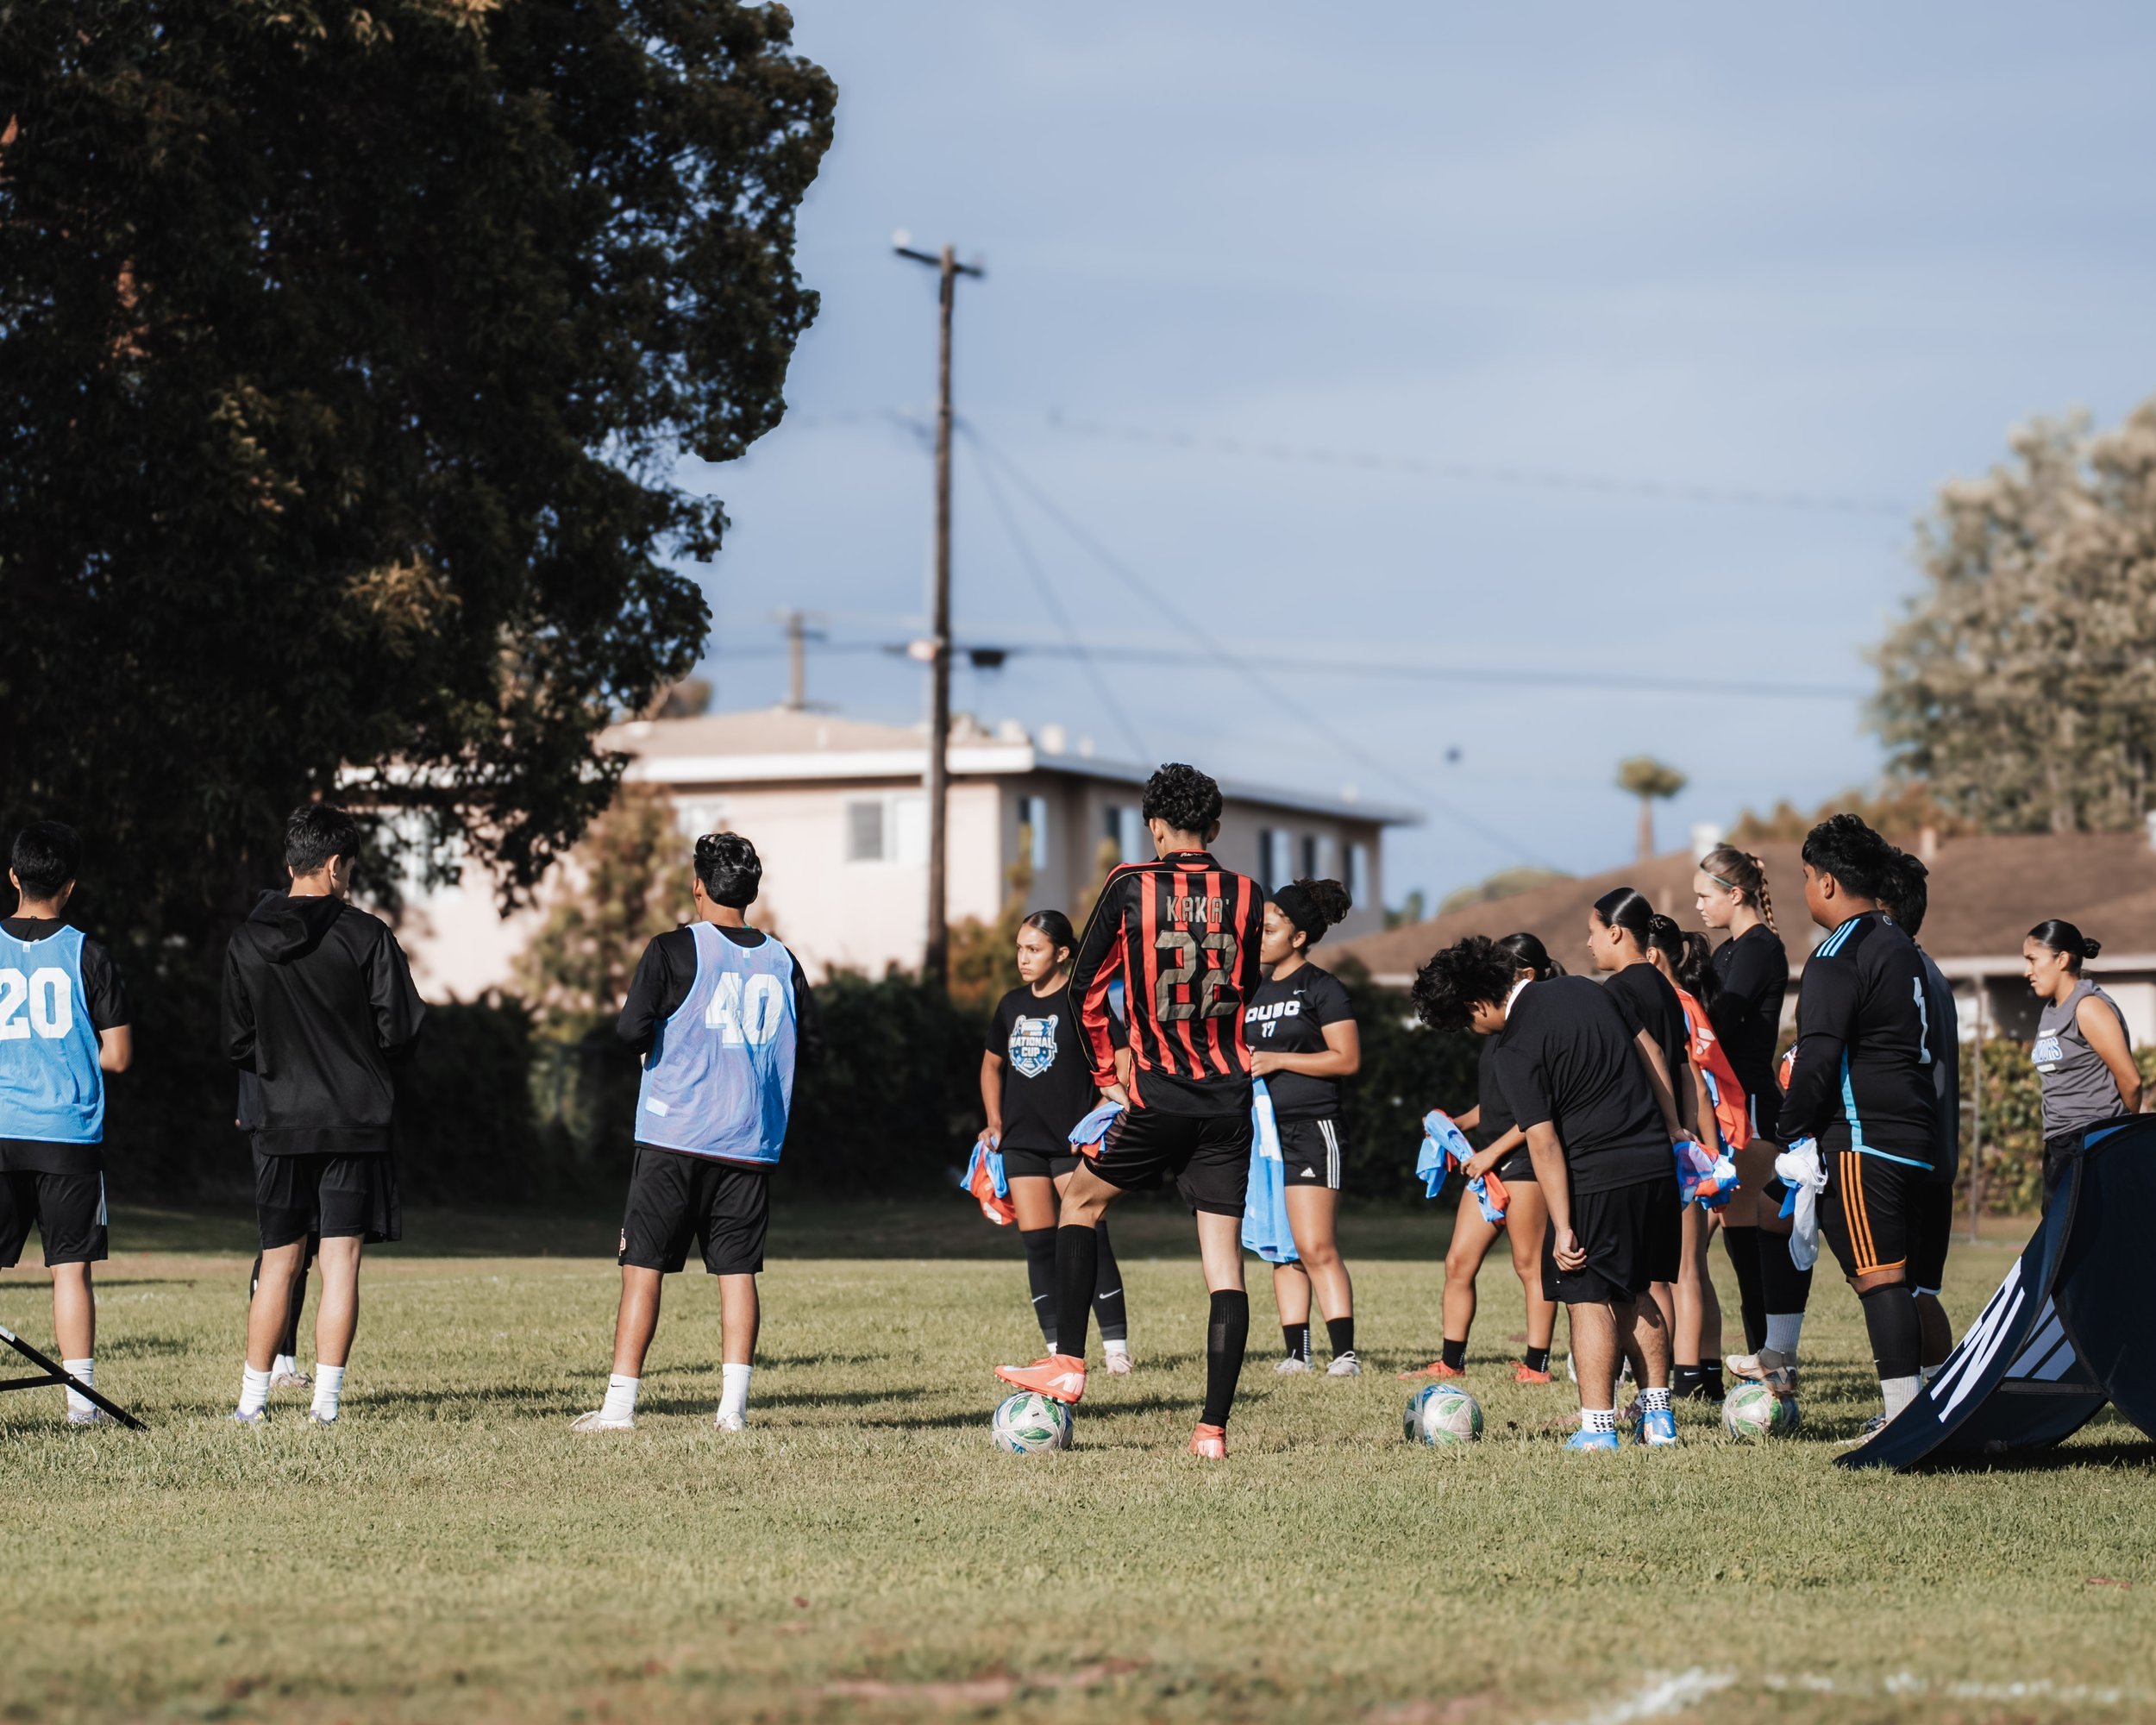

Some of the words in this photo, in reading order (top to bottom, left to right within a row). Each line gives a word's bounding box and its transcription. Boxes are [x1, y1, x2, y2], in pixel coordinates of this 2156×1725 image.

[1154, 930, 1241, 1022] 22
[0, 967, 73, 1040] 20
[705, 971, 783, 1046] 40
[1009, 1035, 1054, 1050] NATIONAL
[1020, 1046, 1041, 1057] CUP
[1261, 1020, 1276, 1038] 17
